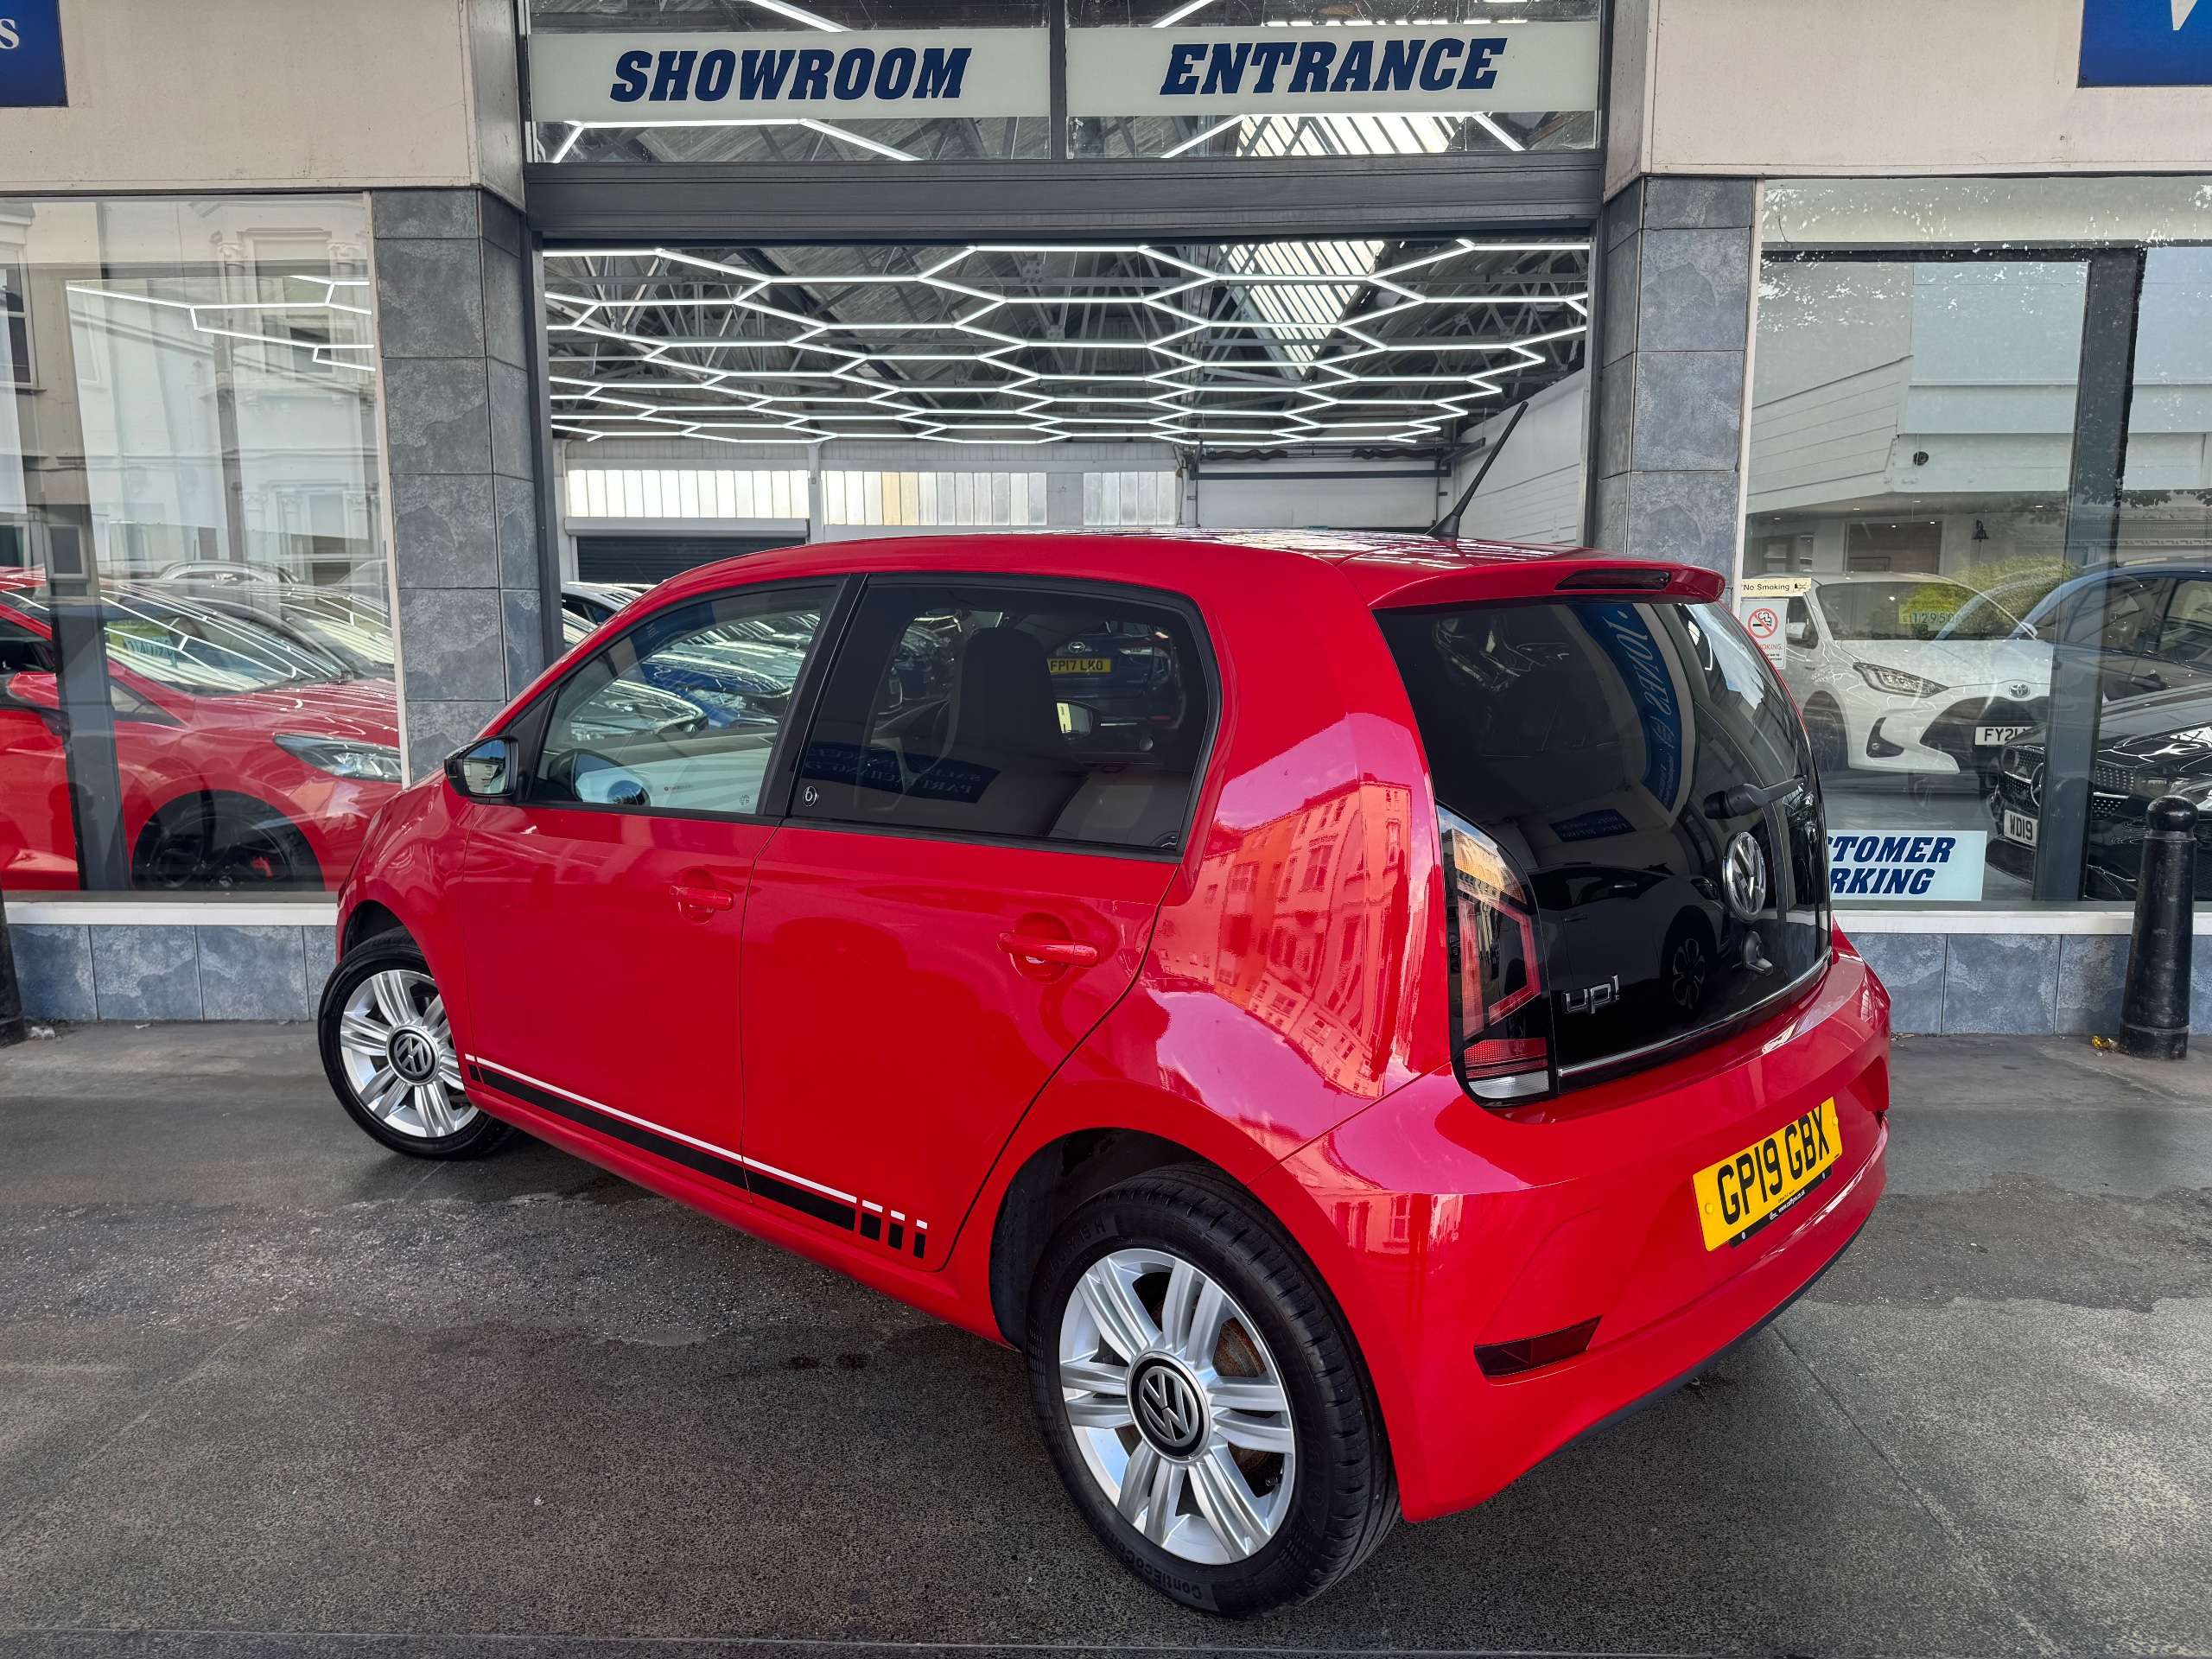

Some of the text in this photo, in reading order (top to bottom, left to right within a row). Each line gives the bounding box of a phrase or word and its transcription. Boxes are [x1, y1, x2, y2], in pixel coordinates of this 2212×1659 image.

[610, 48, 973, 102] SHOWROOM
[1160, 37, 1508, 96] ENTRANCE
[1051, 660, 1077, 671] FP17
[2009, 814, 2033, 841] WD19
[1562, 974, 1620, 1014] up!
[1717, 1105, 1830, 1225] GP19 GBX
